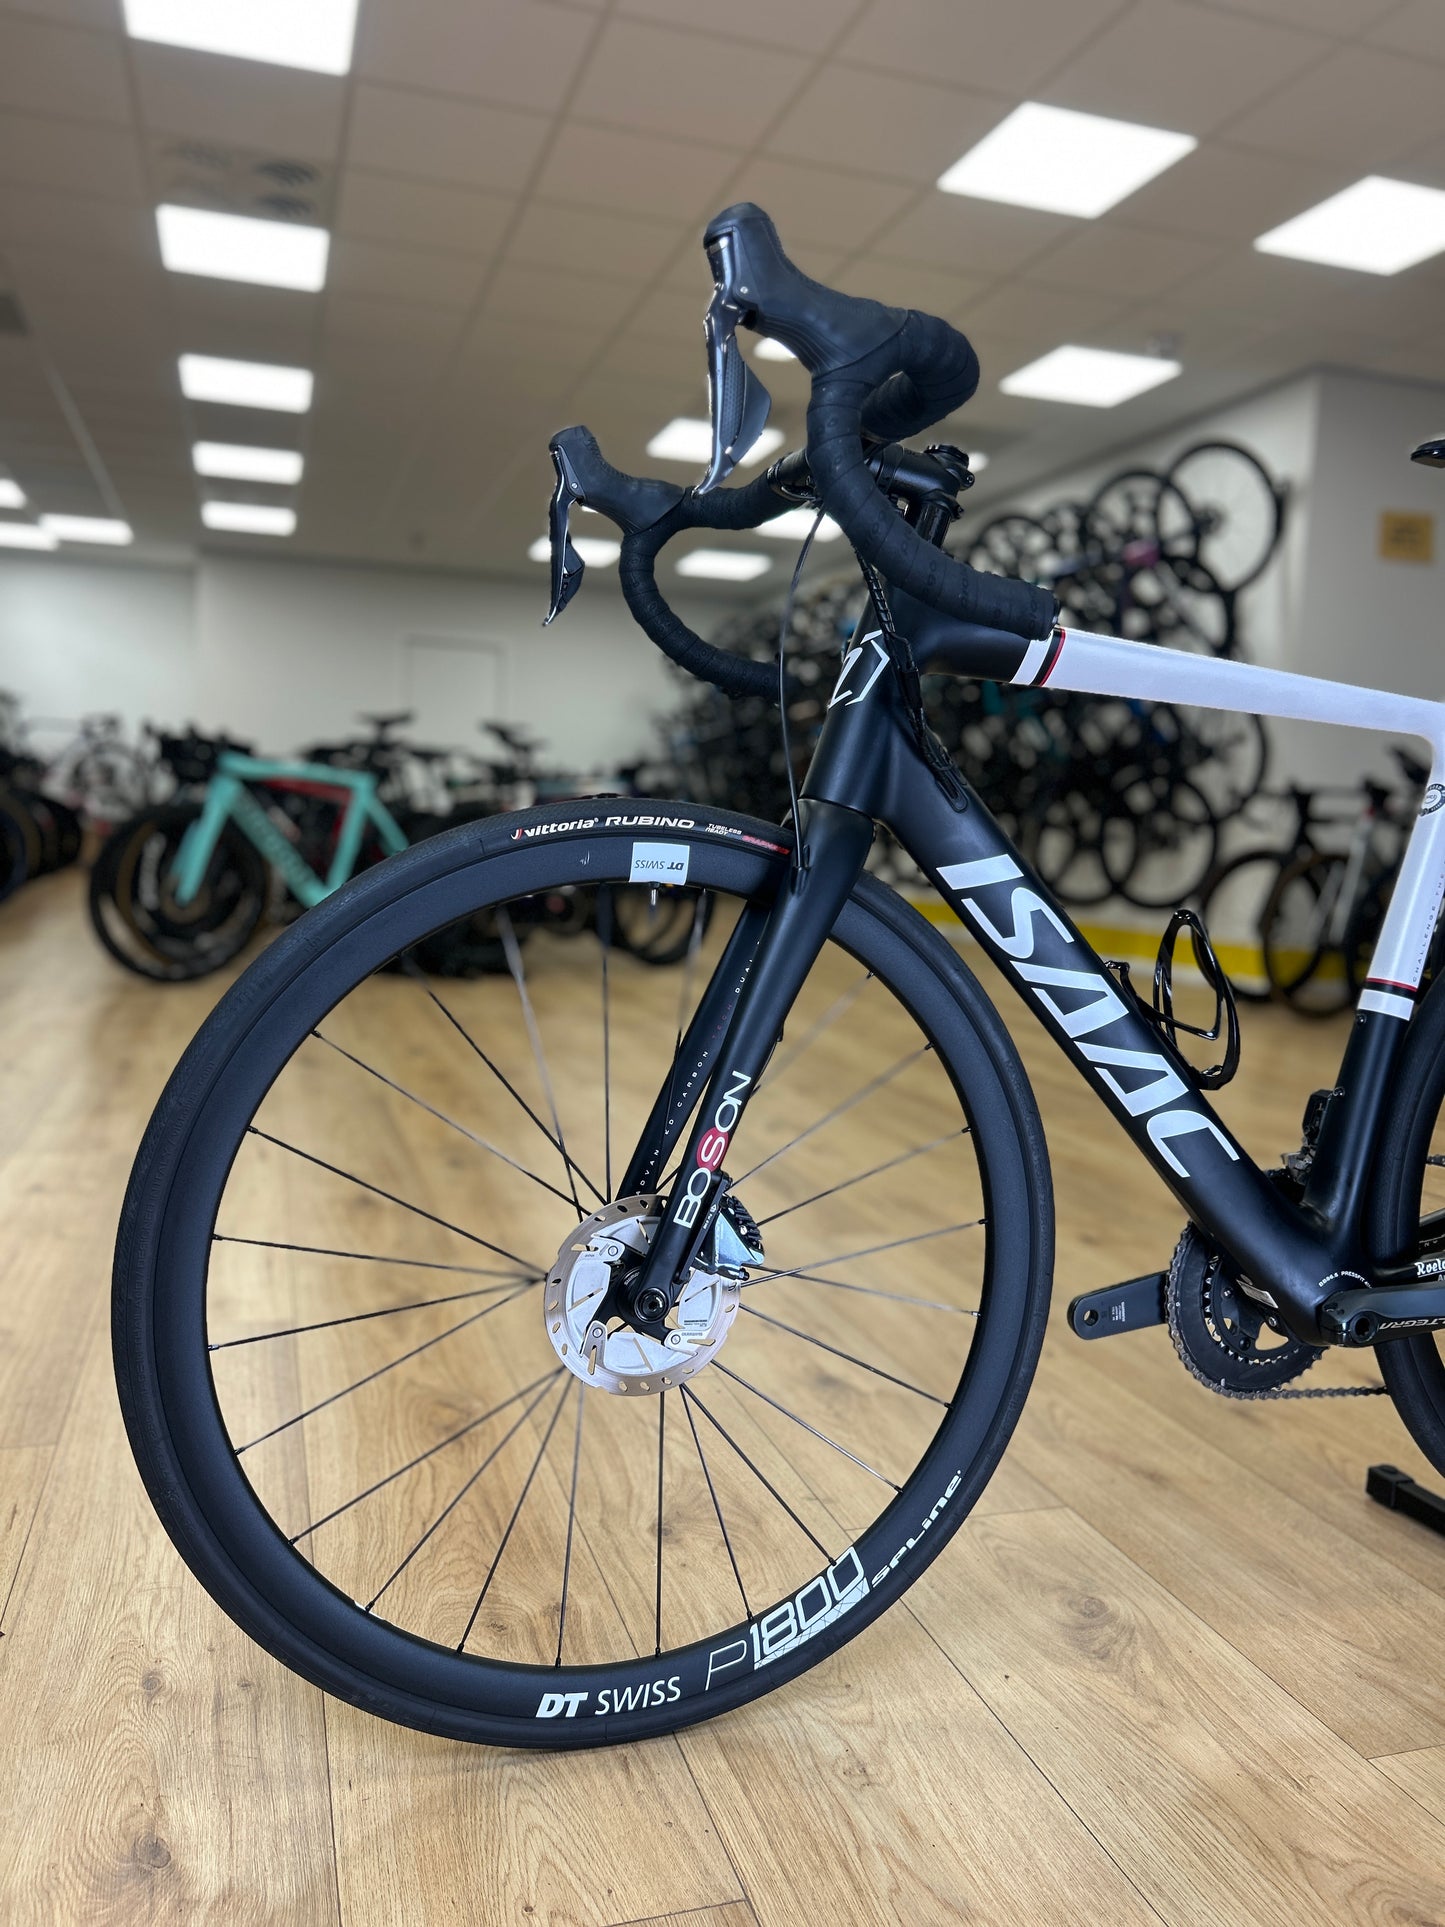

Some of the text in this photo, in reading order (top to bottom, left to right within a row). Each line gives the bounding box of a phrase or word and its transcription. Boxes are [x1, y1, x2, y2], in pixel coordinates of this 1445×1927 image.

[604, 816, 695, 829] RUBINO
[634, 859, 685, 871] DT SWISS
[935, 853, 1240, 1179] ISAAC
[635, 1118, 675, 1196] ADVANED
[677, 1051, 709, 1108] CARBON
[672, 1070, 752, 1229] BOSON
[535, 1691, 589, 1719] DT
[594, 1676, 681, 1716] SWISS
